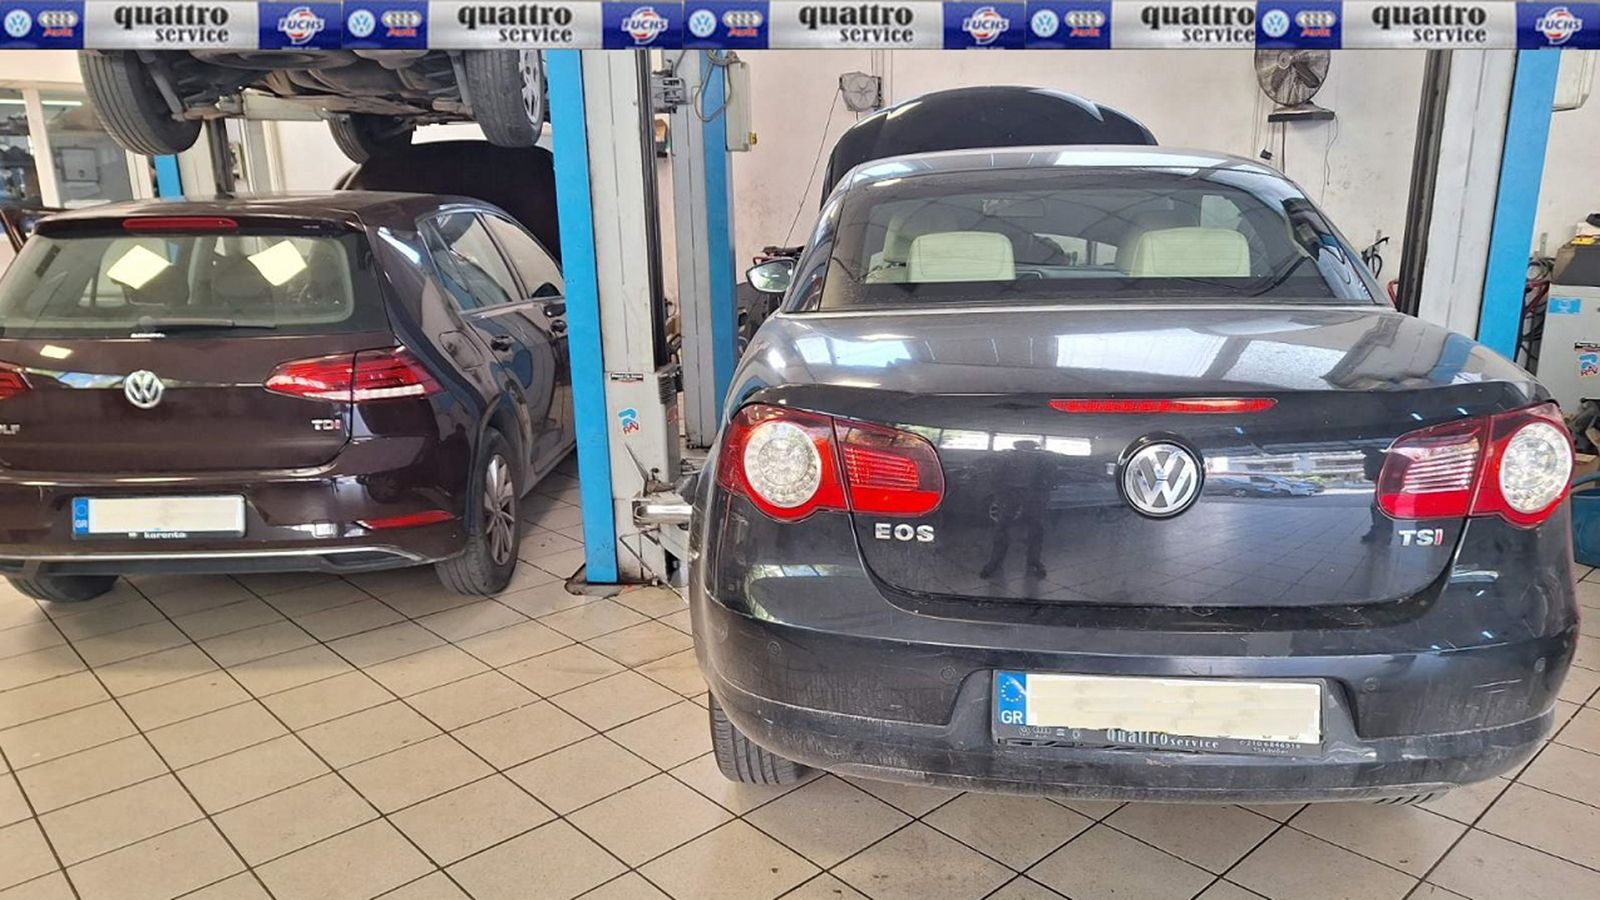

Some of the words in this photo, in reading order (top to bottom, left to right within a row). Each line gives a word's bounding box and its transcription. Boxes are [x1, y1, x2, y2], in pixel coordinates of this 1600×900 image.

[311, 419, 341, 430] TDI
[75, 519, 88, 528] GR
[874, 522, 935, 542] EOS
[1398, 529, 1444, 546] TSI
[1001, 710, 1024, 724] GR
[1170, 737, 1219, 749] service
